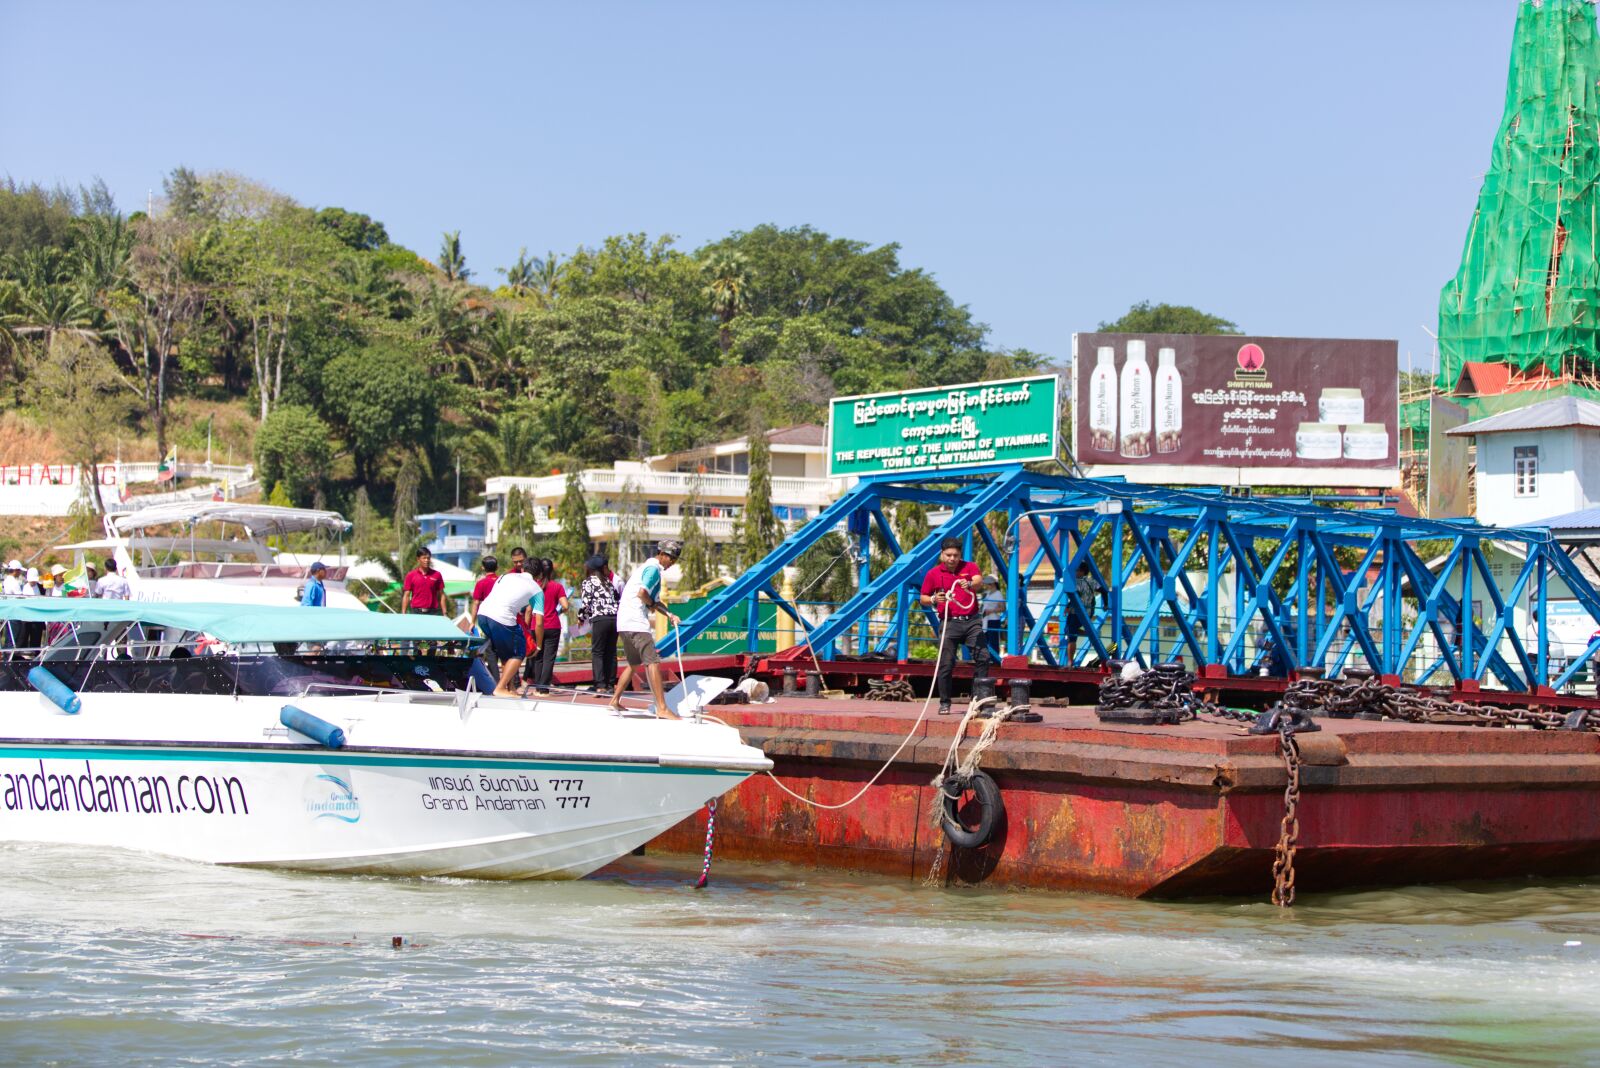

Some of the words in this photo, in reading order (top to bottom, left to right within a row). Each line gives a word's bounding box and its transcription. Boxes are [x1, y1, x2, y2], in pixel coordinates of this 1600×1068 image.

[1227, 381, 1244, 389] SHWE
[1244, 381, 1255, 389] PYI
[1255, 381, 1273, 389] NANN
[836, 451, 855, 462] THE
[857, 447, 903, 460] REPUBLIC
[905, 445, 919, 455] OF
[922, 443, 942, 453] THE
[945, 440, 976, 452] UNION
[979, 438, 992, 449] OF
[882, 457, 912, 469] TOWN
[914, 455, 928, 466] OF
[930, 450, 995, 464] KAWTHAUNG
[706, 631, 718, 640] THE
[0, 759, 249, 815] andandaman.com
[429, 774, 473, 792] แกรนด์
[480, 773, 539, 792] อันดามัน
[548, 779, 583, 792] 777
[422, 793, 468, 811] Grand
[475, 795, 546, 811] Andaman
[556, 796, 591, 809] 777
